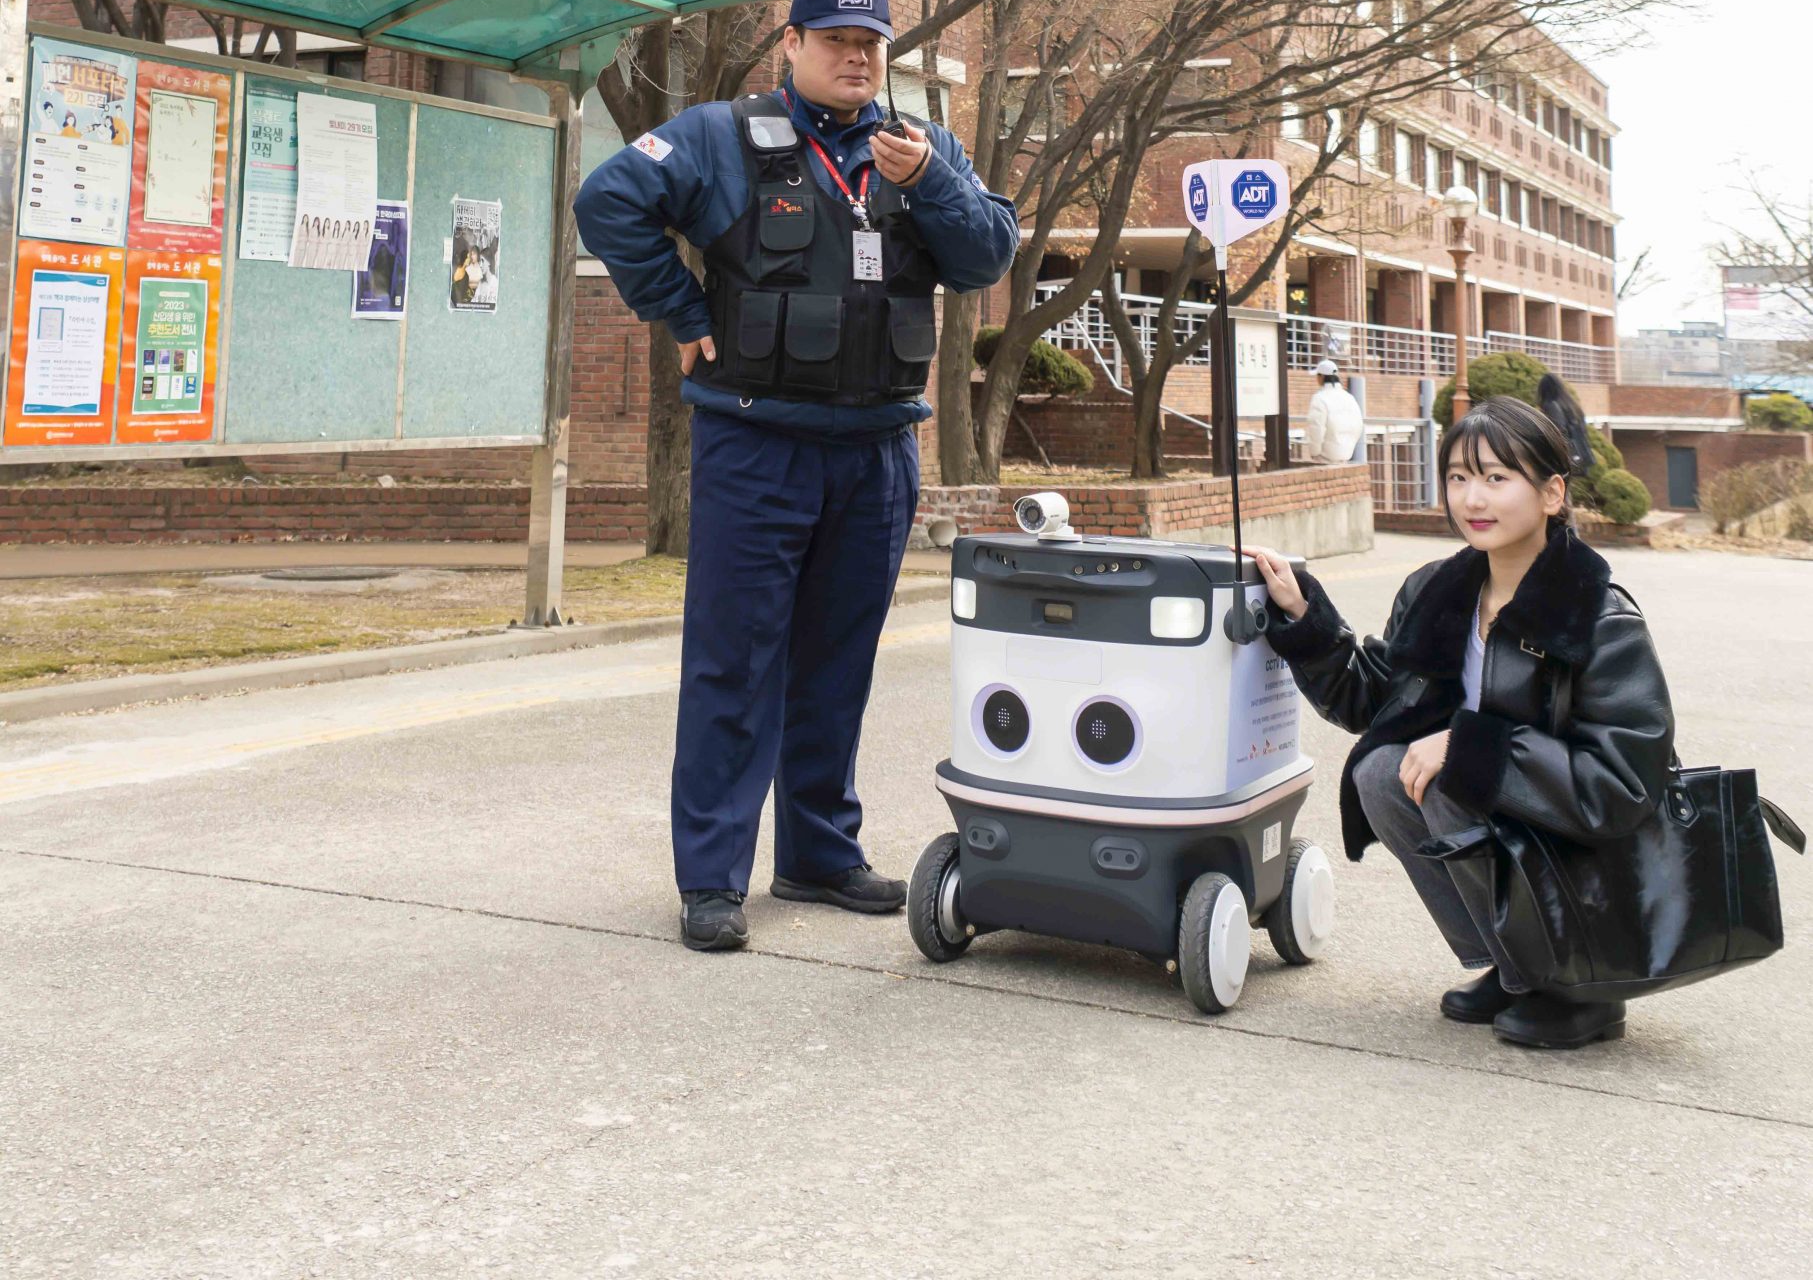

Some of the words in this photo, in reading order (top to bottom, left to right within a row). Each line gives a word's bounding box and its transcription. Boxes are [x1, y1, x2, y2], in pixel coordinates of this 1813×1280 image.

[251, 125, 283, 143] 교육생
[250, 141, 272, 158] 모집
[1193, 189, 1205, 206] ADT
[1240, 186, 1269, 202] ADT
[70, 253, 103, 268] 도서관
[173, 261, 201, 273] 도서관
[164, 301, 184, 310] 2023
[148, 323, 180, 335] 추천도서
[181, 324, 197, 335] 전시
[1265, 659, 1280, 671] CCTV
